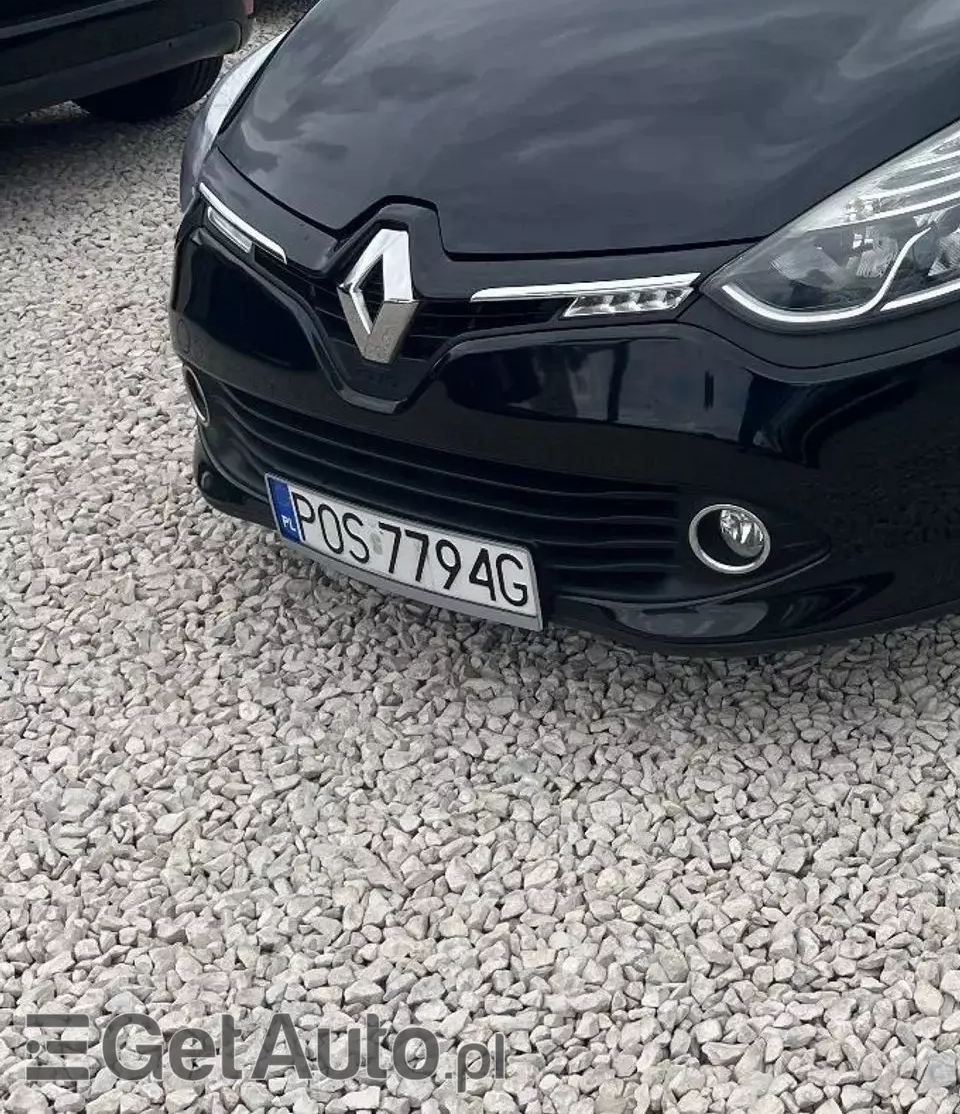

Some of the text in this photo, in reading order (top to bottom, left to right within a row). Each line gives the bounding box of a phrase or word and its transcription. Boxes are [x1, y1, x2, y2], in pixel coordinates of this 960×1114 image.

[281, 515, 296, 532] PL
[293, 492, 529, 607] POS 7794G
